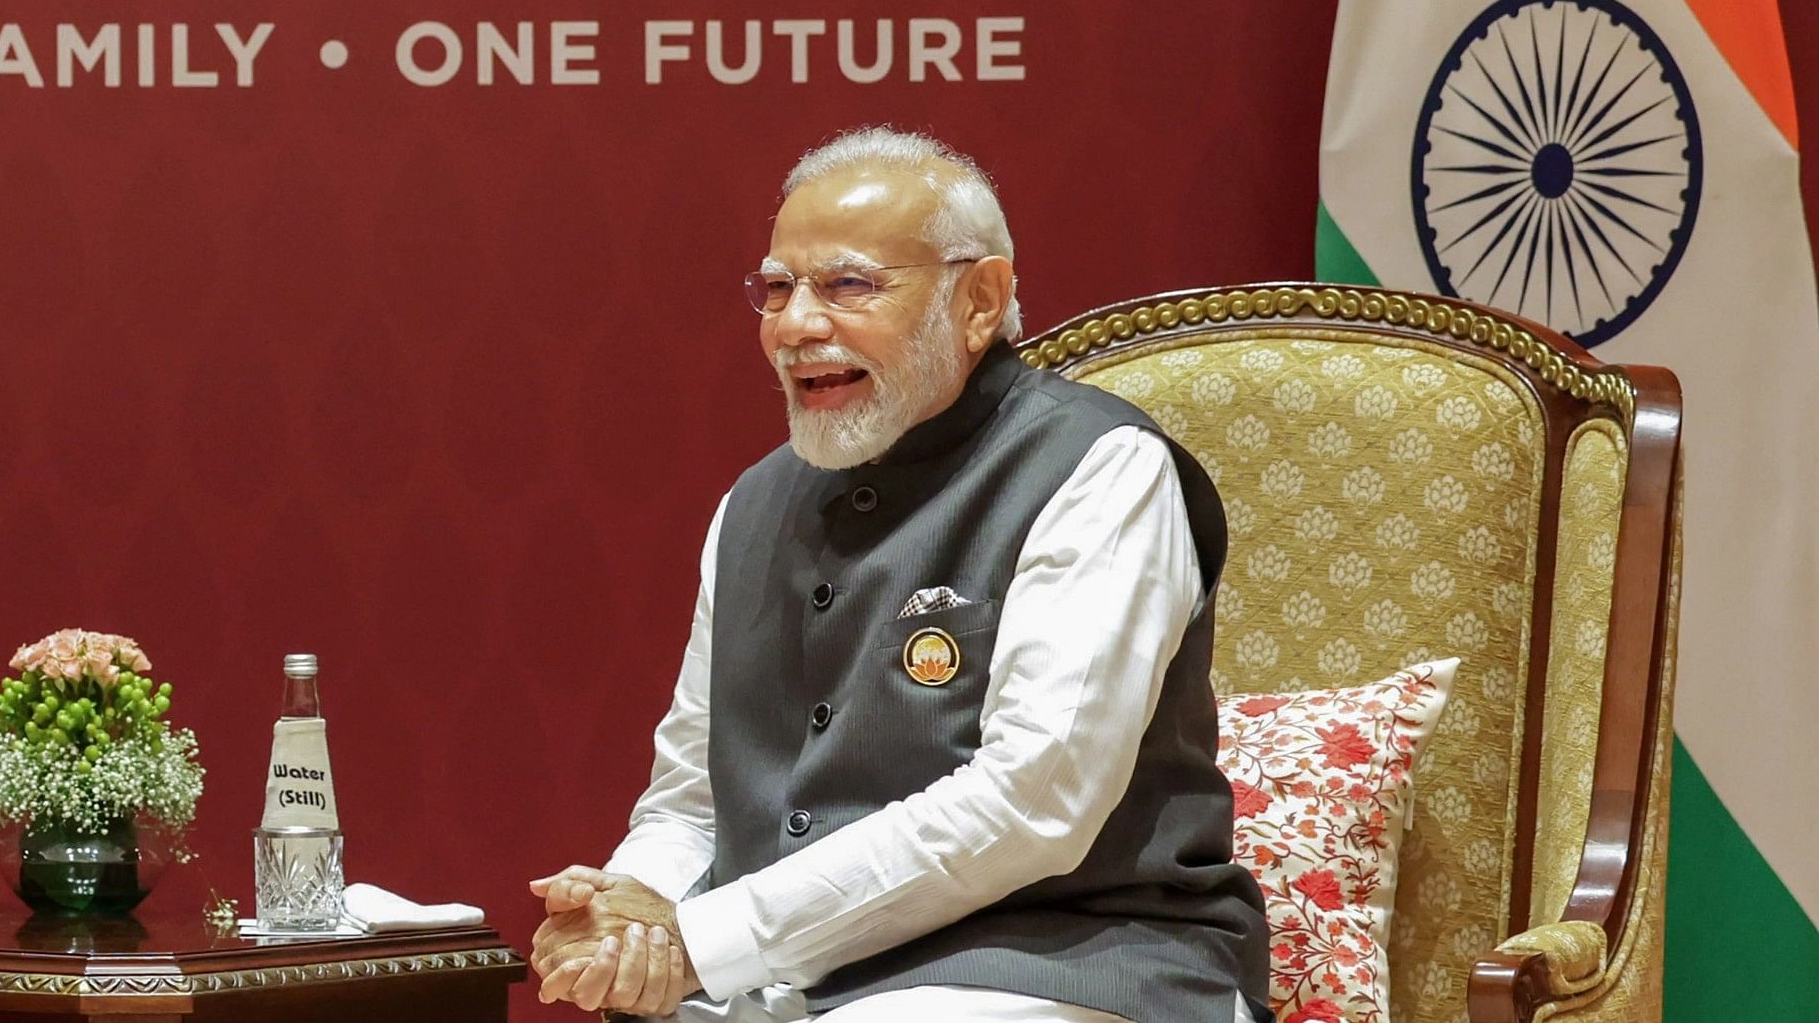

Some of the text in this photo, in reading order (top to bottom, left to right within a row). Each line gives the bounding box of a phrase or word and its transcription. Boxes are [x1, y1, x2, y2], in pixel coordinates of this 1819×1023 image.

[396, 21, 600, 86] ONE
[645, 18, 1025, 84] FUTURE
[273, 764, 326, 781] Water
[279, 789, 327, 810] (Still)
